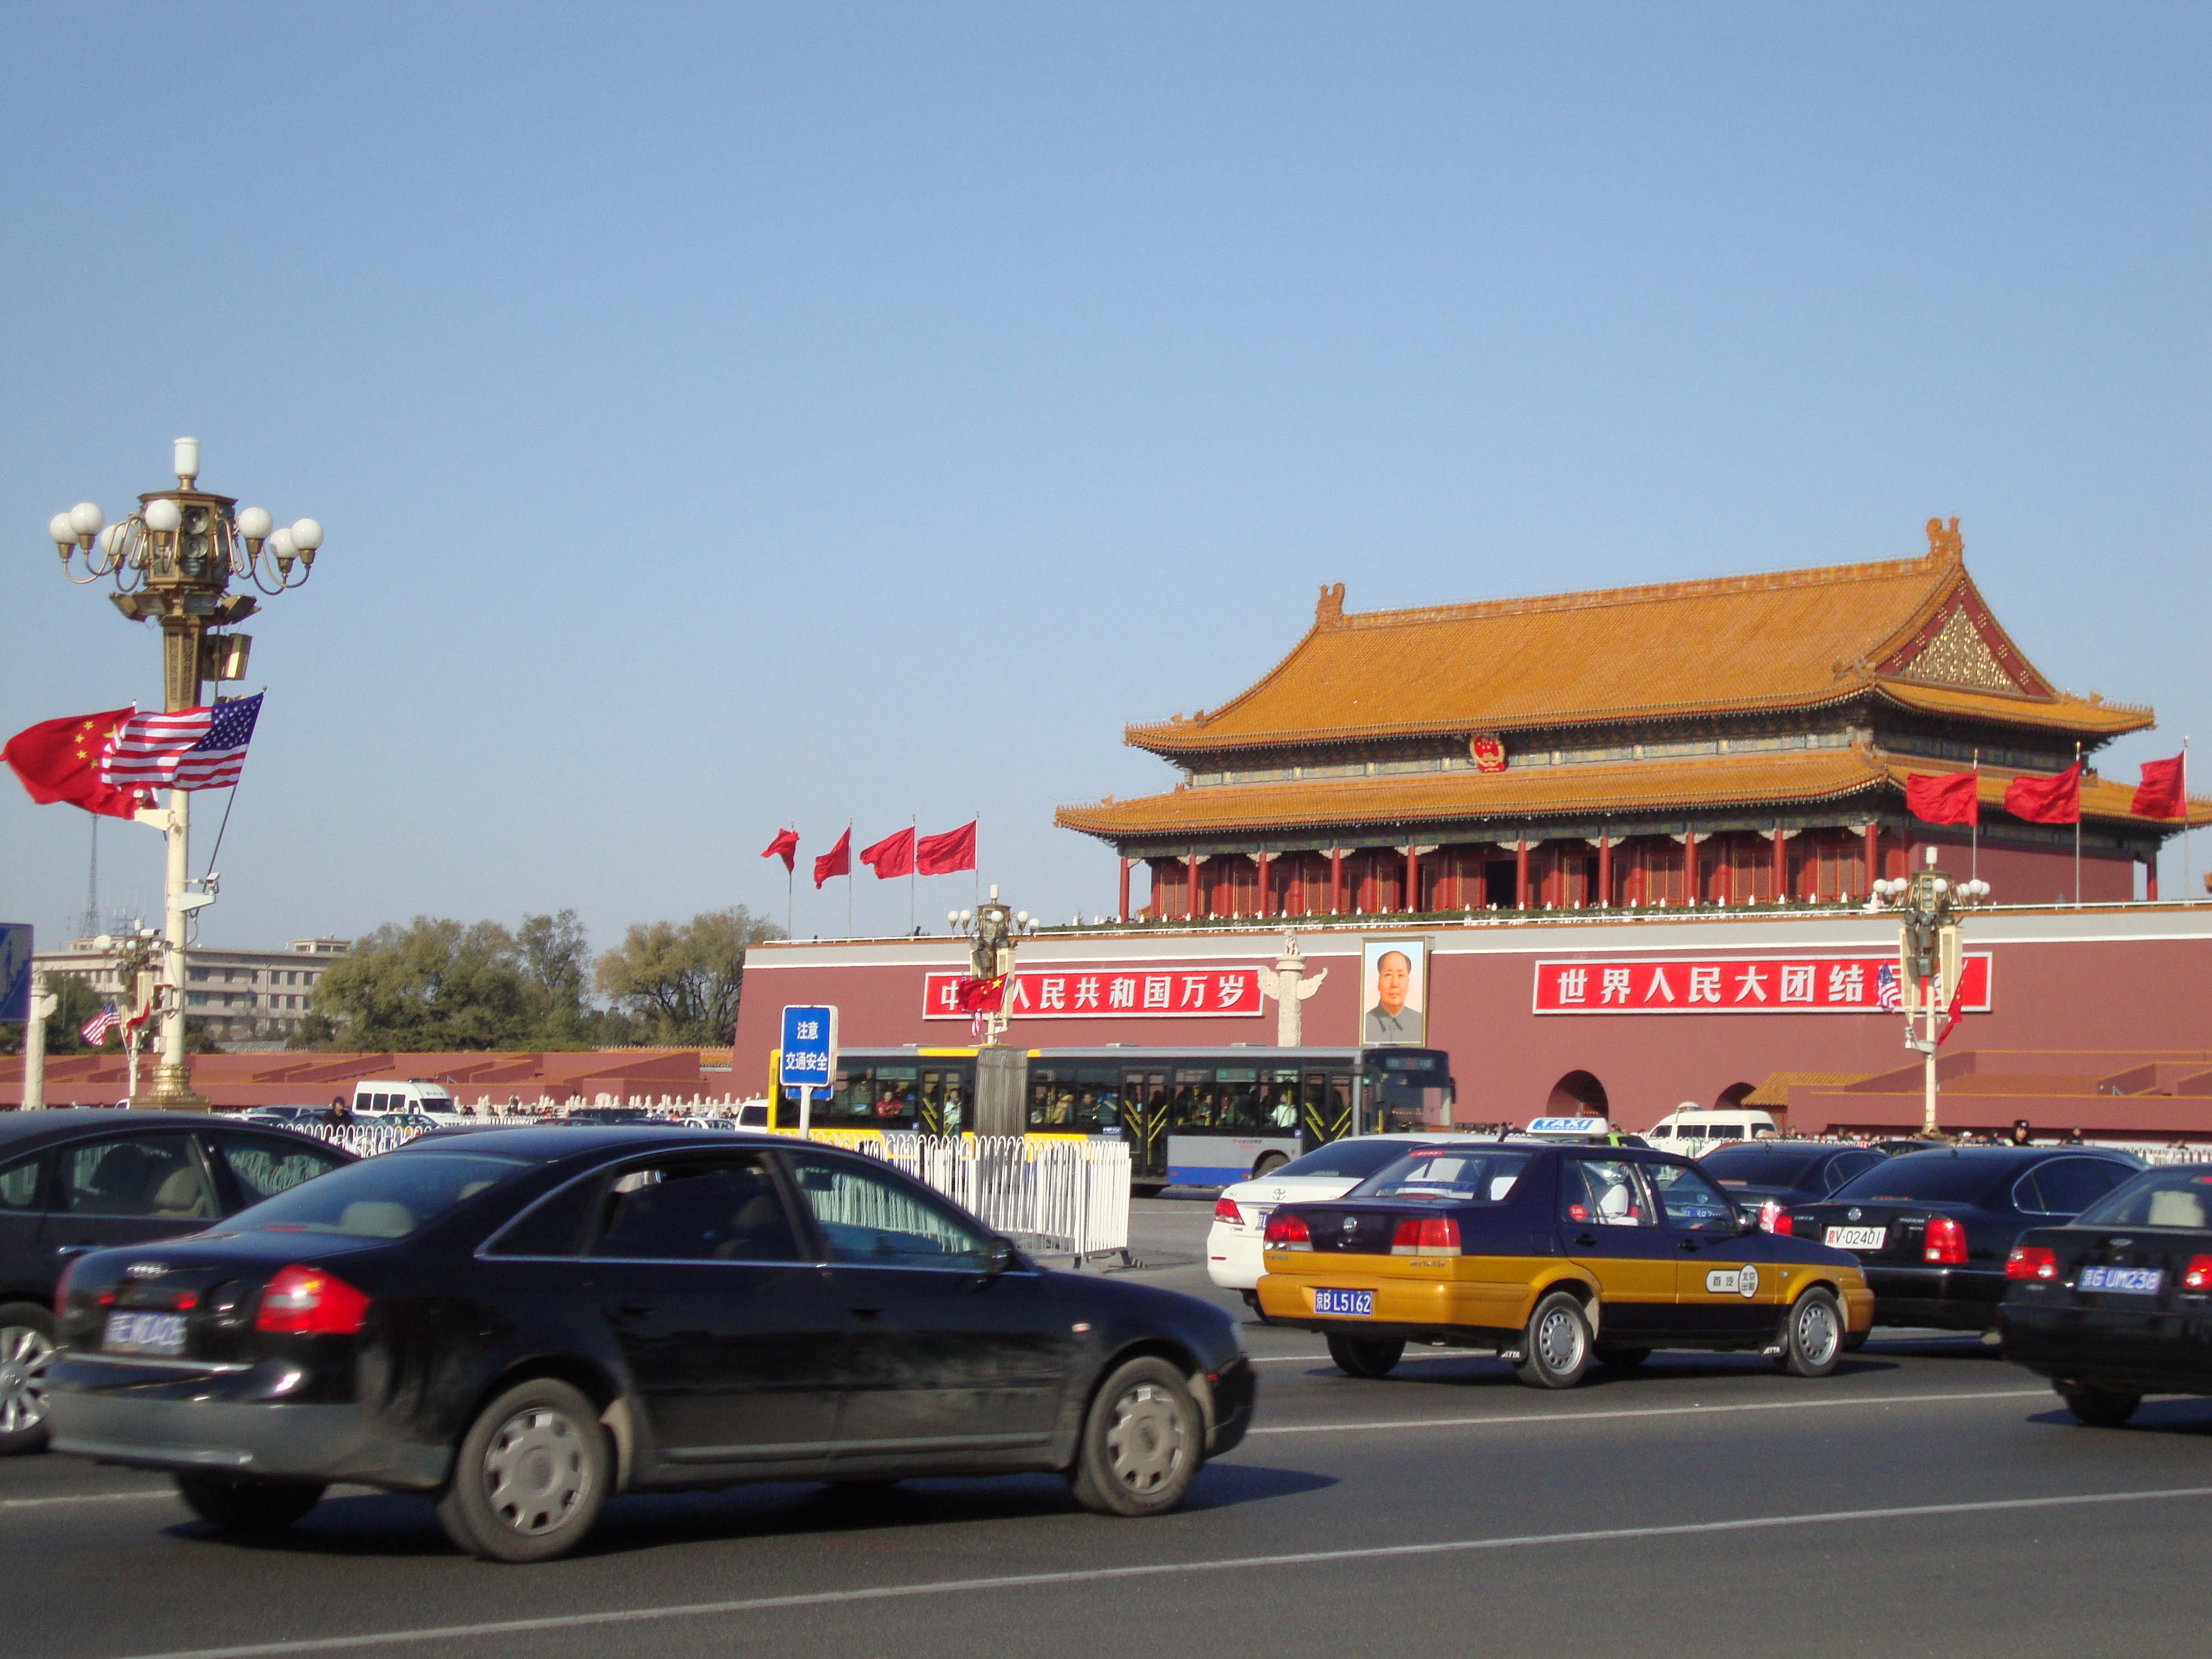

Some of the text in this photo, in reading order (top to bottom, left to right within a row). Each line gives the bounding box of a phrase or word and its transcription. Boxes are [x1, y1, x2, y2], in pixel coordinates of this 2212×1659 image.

[941, 974, 1244, 1011] 中人民共和国万岁
[1557, 964, 1952, 1004] 世界人民大团结
[797, 1021, 819, 1040] 注意
[785, 1052, 828, 1071] 交通安全
[1541, 1119, 1593, 1127] TAXI
